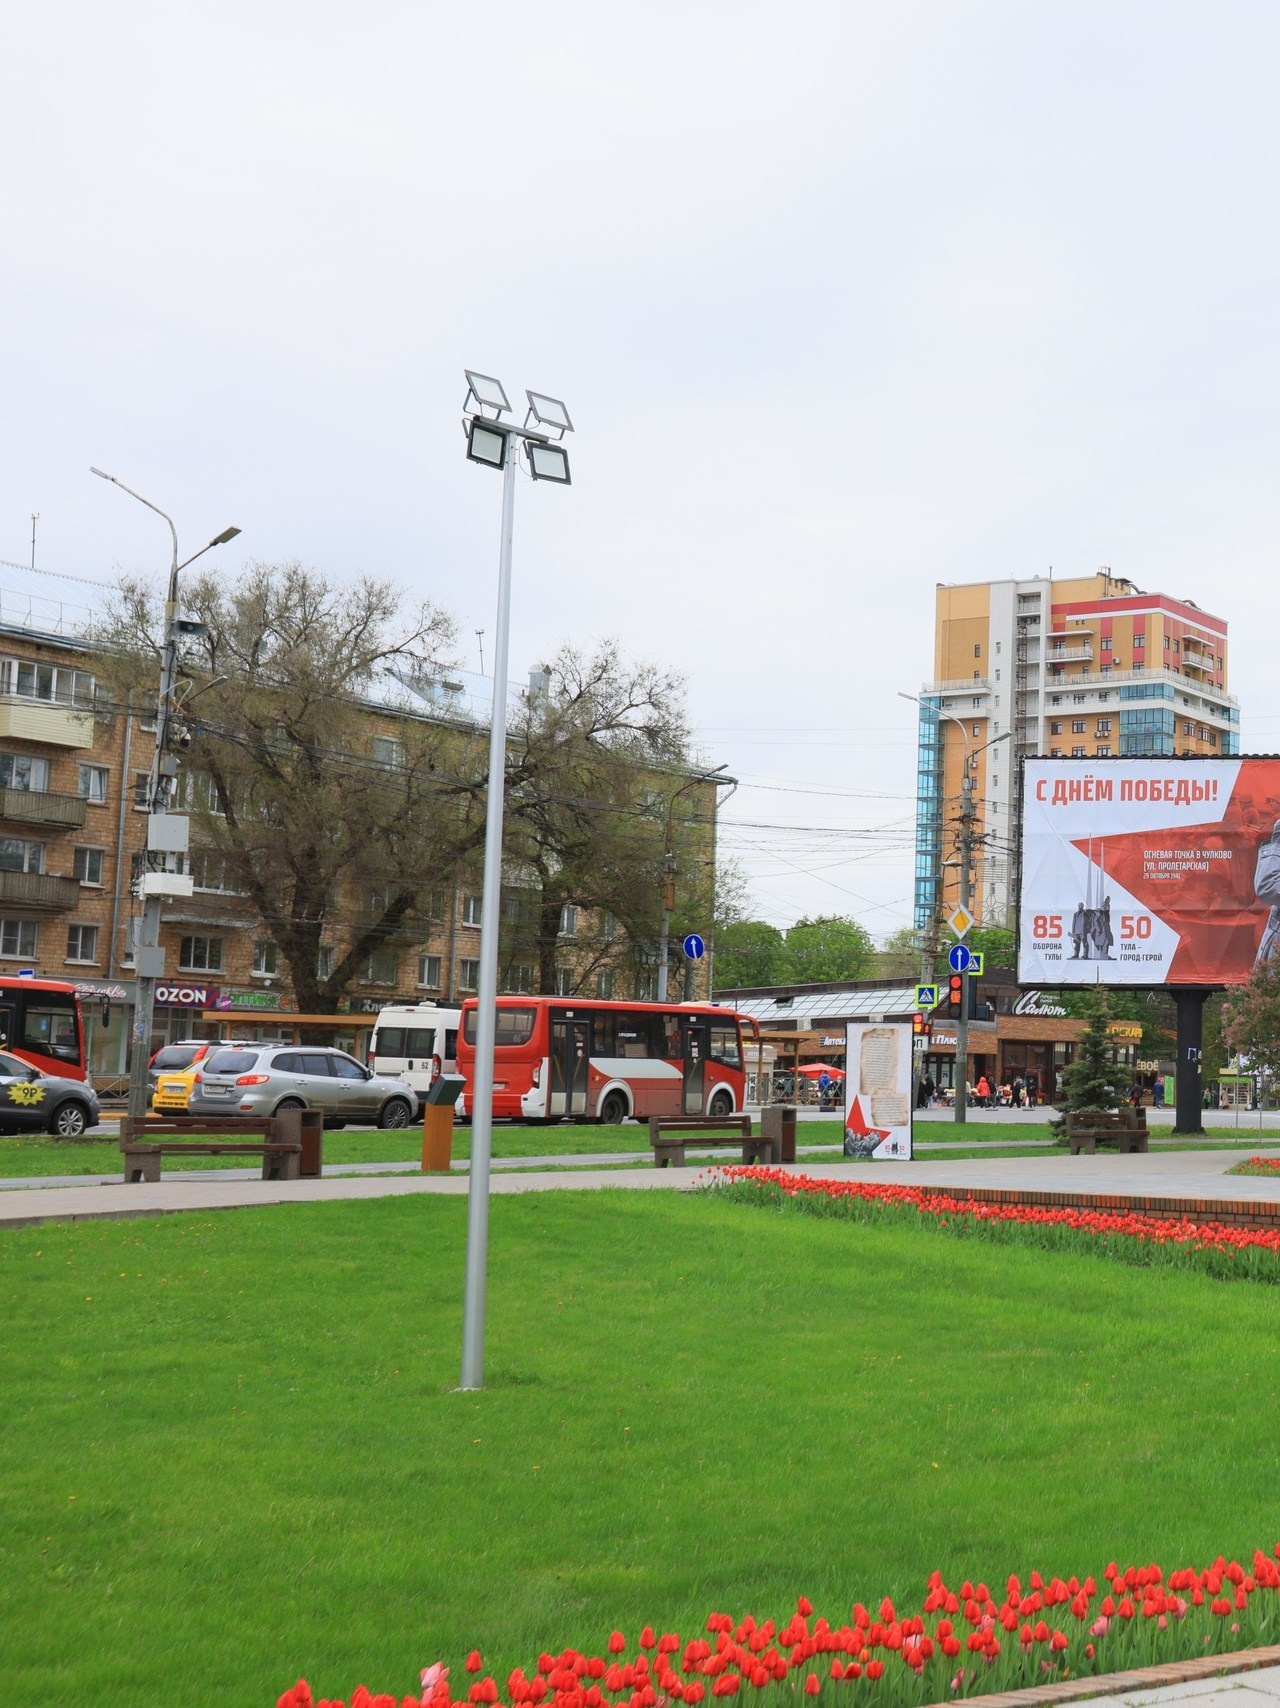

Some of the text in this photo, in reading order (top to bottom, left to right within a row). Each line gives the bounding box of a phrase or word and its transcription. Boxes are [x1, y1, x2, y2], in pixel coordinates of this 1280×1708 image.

[1036, 774, 1218, 806] С ДНЁМ ПОБЕДЫ!
[1143, 850, 1232, 859] ОГНЕВАЯ ТОЧКА В ЧУЛКОВО
[1033, 915, 1063, 939] 85
[1120, 915, 1152, 940] 50
[1032, 942, 1062, 950] ОБОРОНА
[1120, 943, 1137, 951] ТУЛА
[1044, 953, 1062, 961] ТУЛЫ
[1120, 952, 1163, 962] ГОРОД-ГЕРОЙ
[155, 986, 207, 1004] OZON
[421, 1061, 429, 1070] 62
